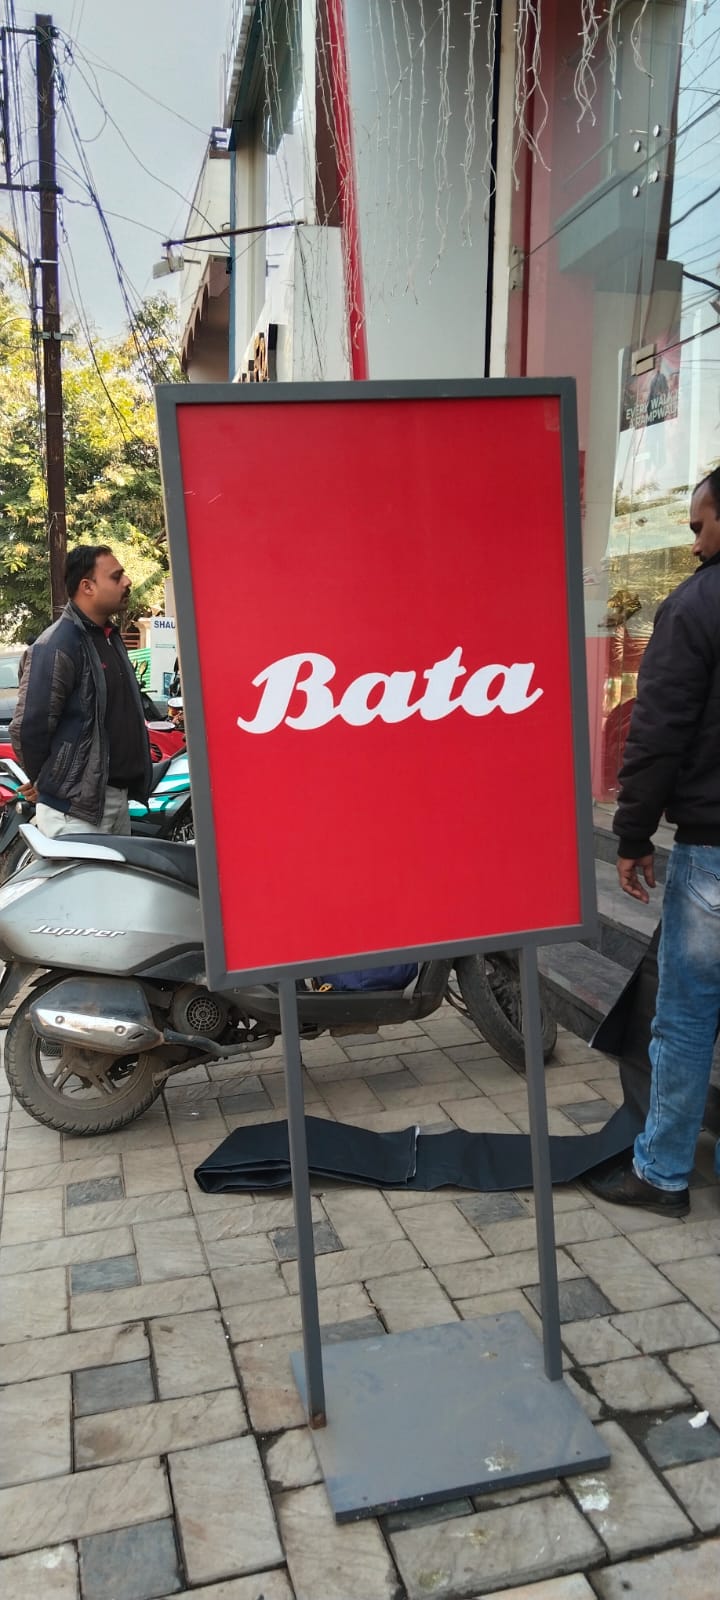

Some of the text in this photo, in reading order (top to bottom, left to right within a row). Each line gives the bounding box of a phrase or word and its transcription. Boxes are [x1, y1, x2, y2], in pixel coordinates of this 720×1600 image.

[626, 403, 649, 420] EVERY
[237, 646, 544, 734] Bata
[29, 924, 127, 938] Jupiter
